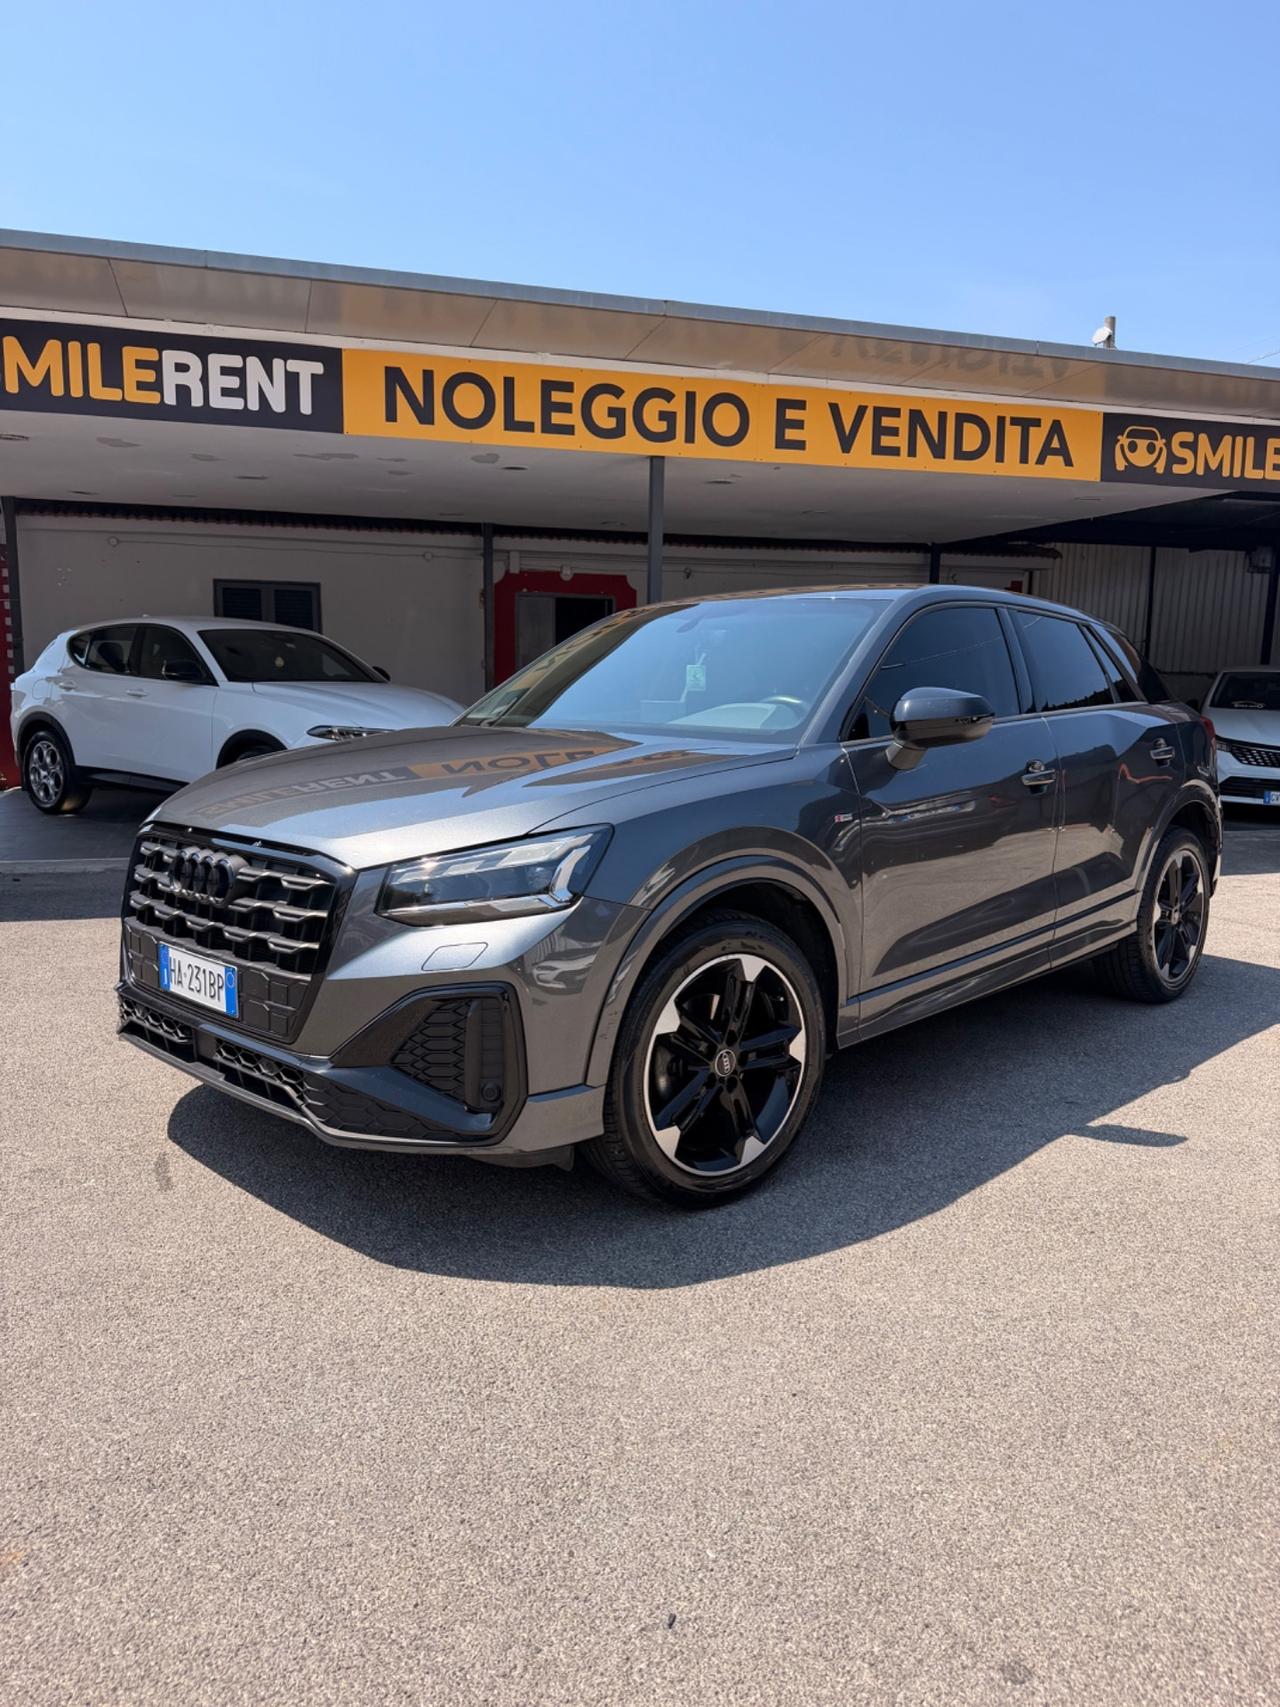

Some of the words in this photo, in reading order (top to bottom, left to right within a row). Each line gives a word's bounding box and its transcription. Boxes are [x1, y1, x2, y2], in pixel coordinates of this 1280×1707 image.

[2, 335, 325, 416] MILERENT
[384, 365, 750, 447] NOLEGGIO
[774, 397, 807, 451] E
[827, 401, 1074, 468] VENDITA
[1171, 431, 1280, 481] SMILE
